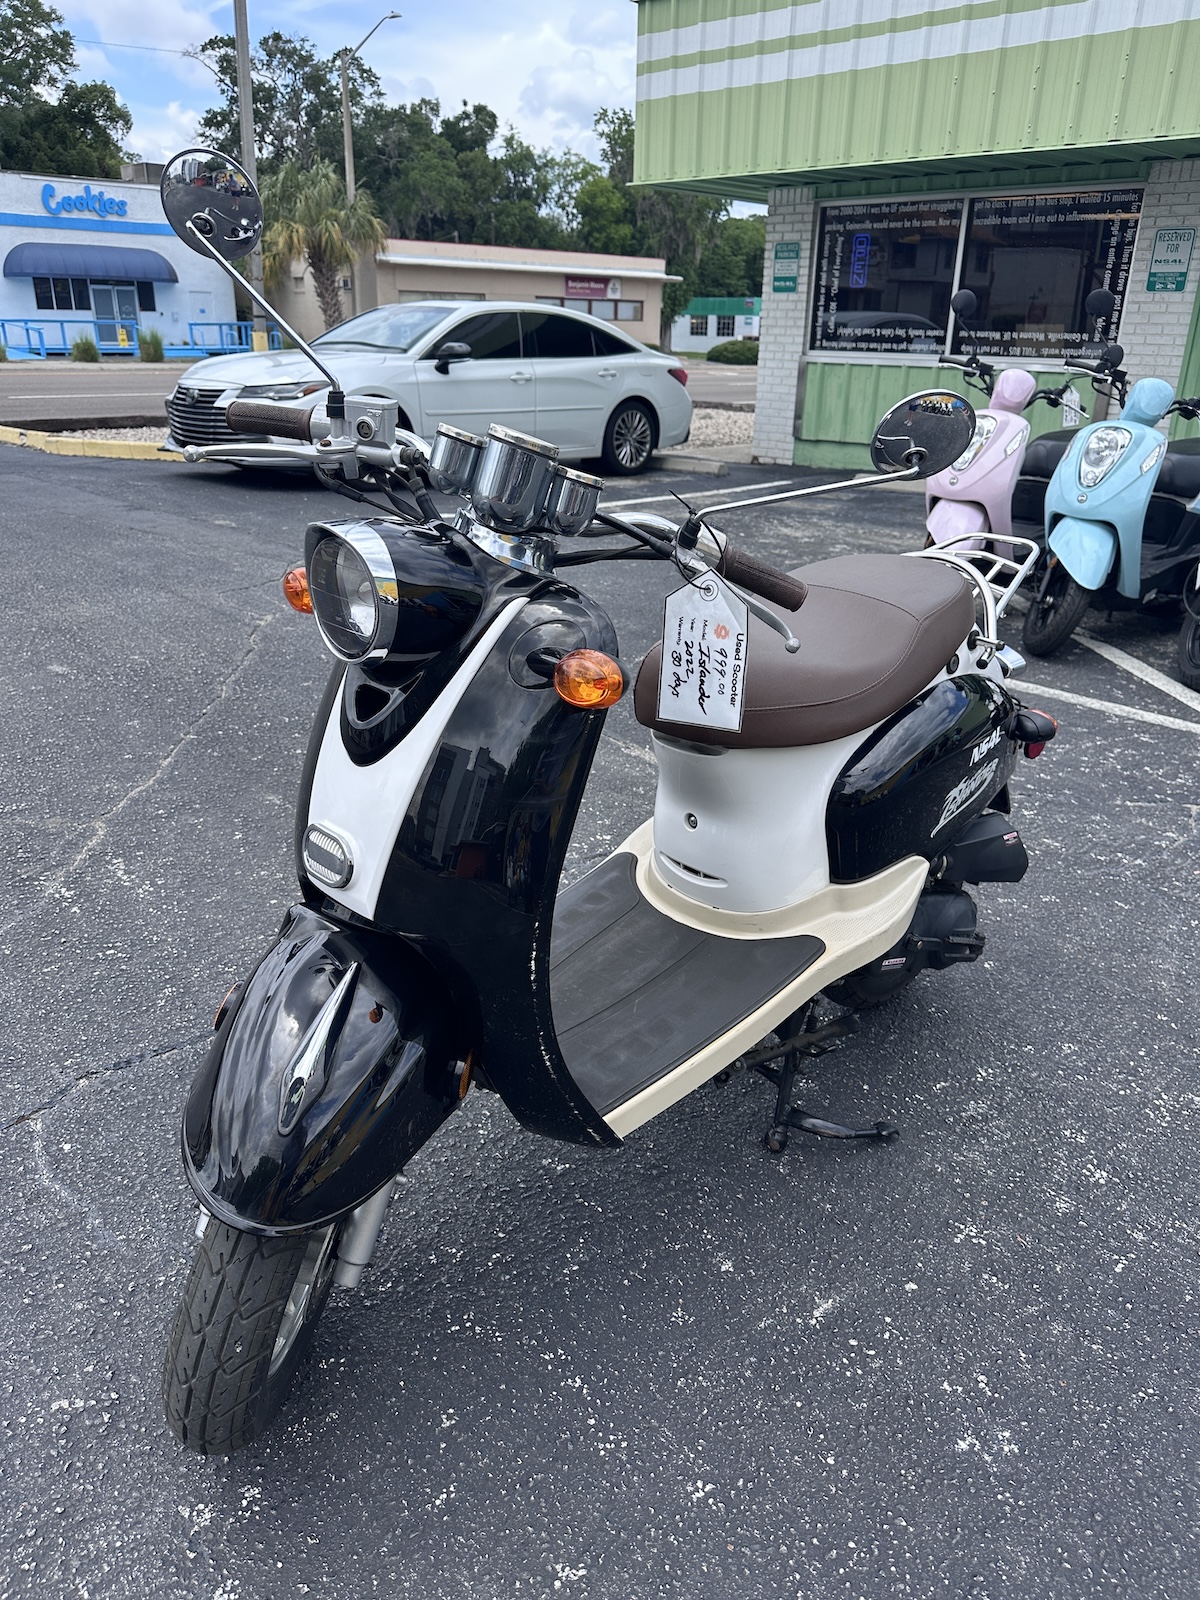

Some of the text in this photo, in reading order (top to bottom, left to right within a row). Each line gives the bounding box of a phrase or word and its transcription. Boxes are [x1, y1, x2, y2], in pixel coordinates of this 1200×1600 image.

[42, 184, 128, 218] Cookies
[1103, 193, 1111, 202] 15
[1112, 190, 1138, 202] minutes
[1122, 245, 1133, 262] Then
[1158, 232, 1192, 242] RESERVED
[1166, 244, 1180, 253] FOR
[853, 238, 866, 285] OPEN
[1116, 271, 1128, 292] drove
[668, 650, 688, 698] 30 days
[684, 641, 694, 680] 2022
[730, 633, 744, 707] Used Scooter
[698, 642, 710, 716] Islander
[969, 725, 1005, 767] NS4L
